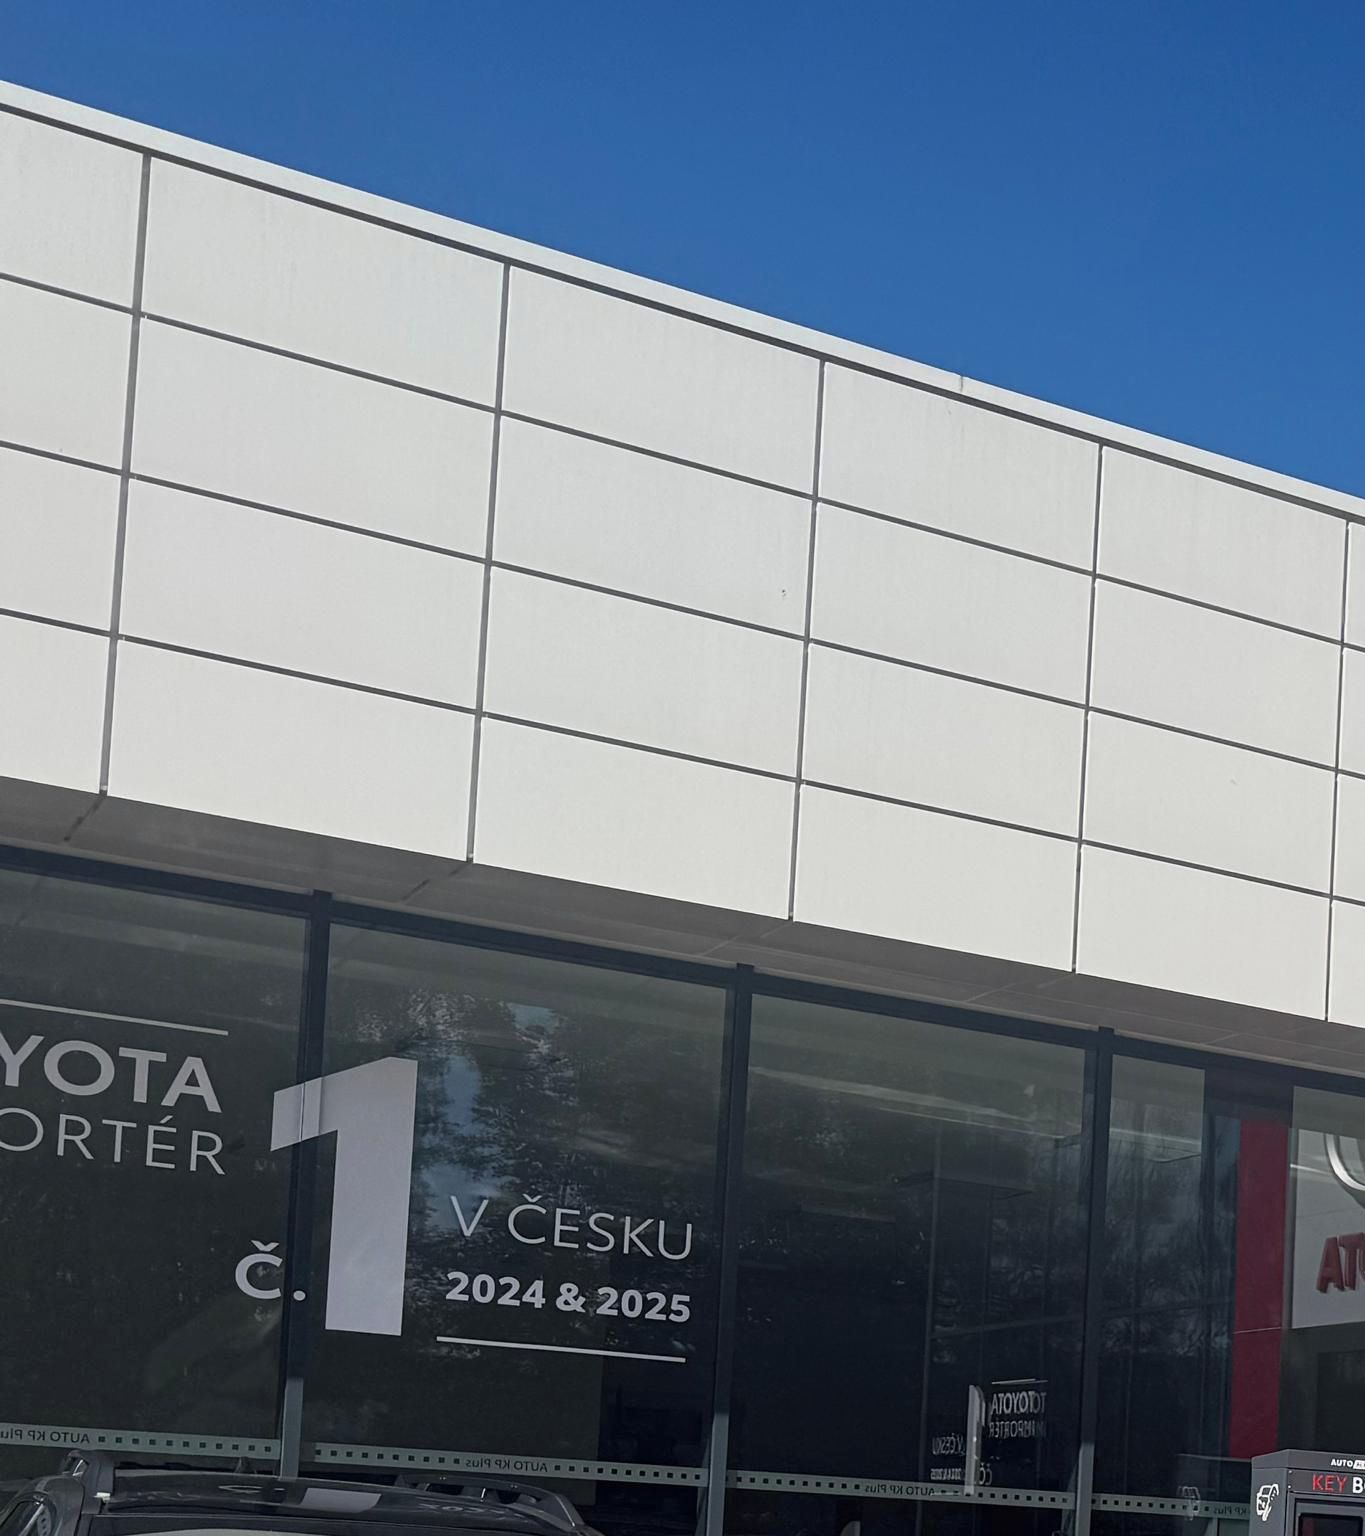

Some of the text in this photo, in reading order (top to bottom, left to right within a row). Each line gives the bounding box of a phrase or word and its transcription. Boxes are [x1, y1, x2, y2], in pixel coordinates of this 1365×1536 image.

[271, 1056, 418, 1336] 1
[450, 1193, 693, 1260] V ČESKU
[446, 1271, 691, 1322] 2024 & 2025
[1312, 1474, 1348, 1492] KEY
[1330, 1459, 1353, 1467] AUTO
